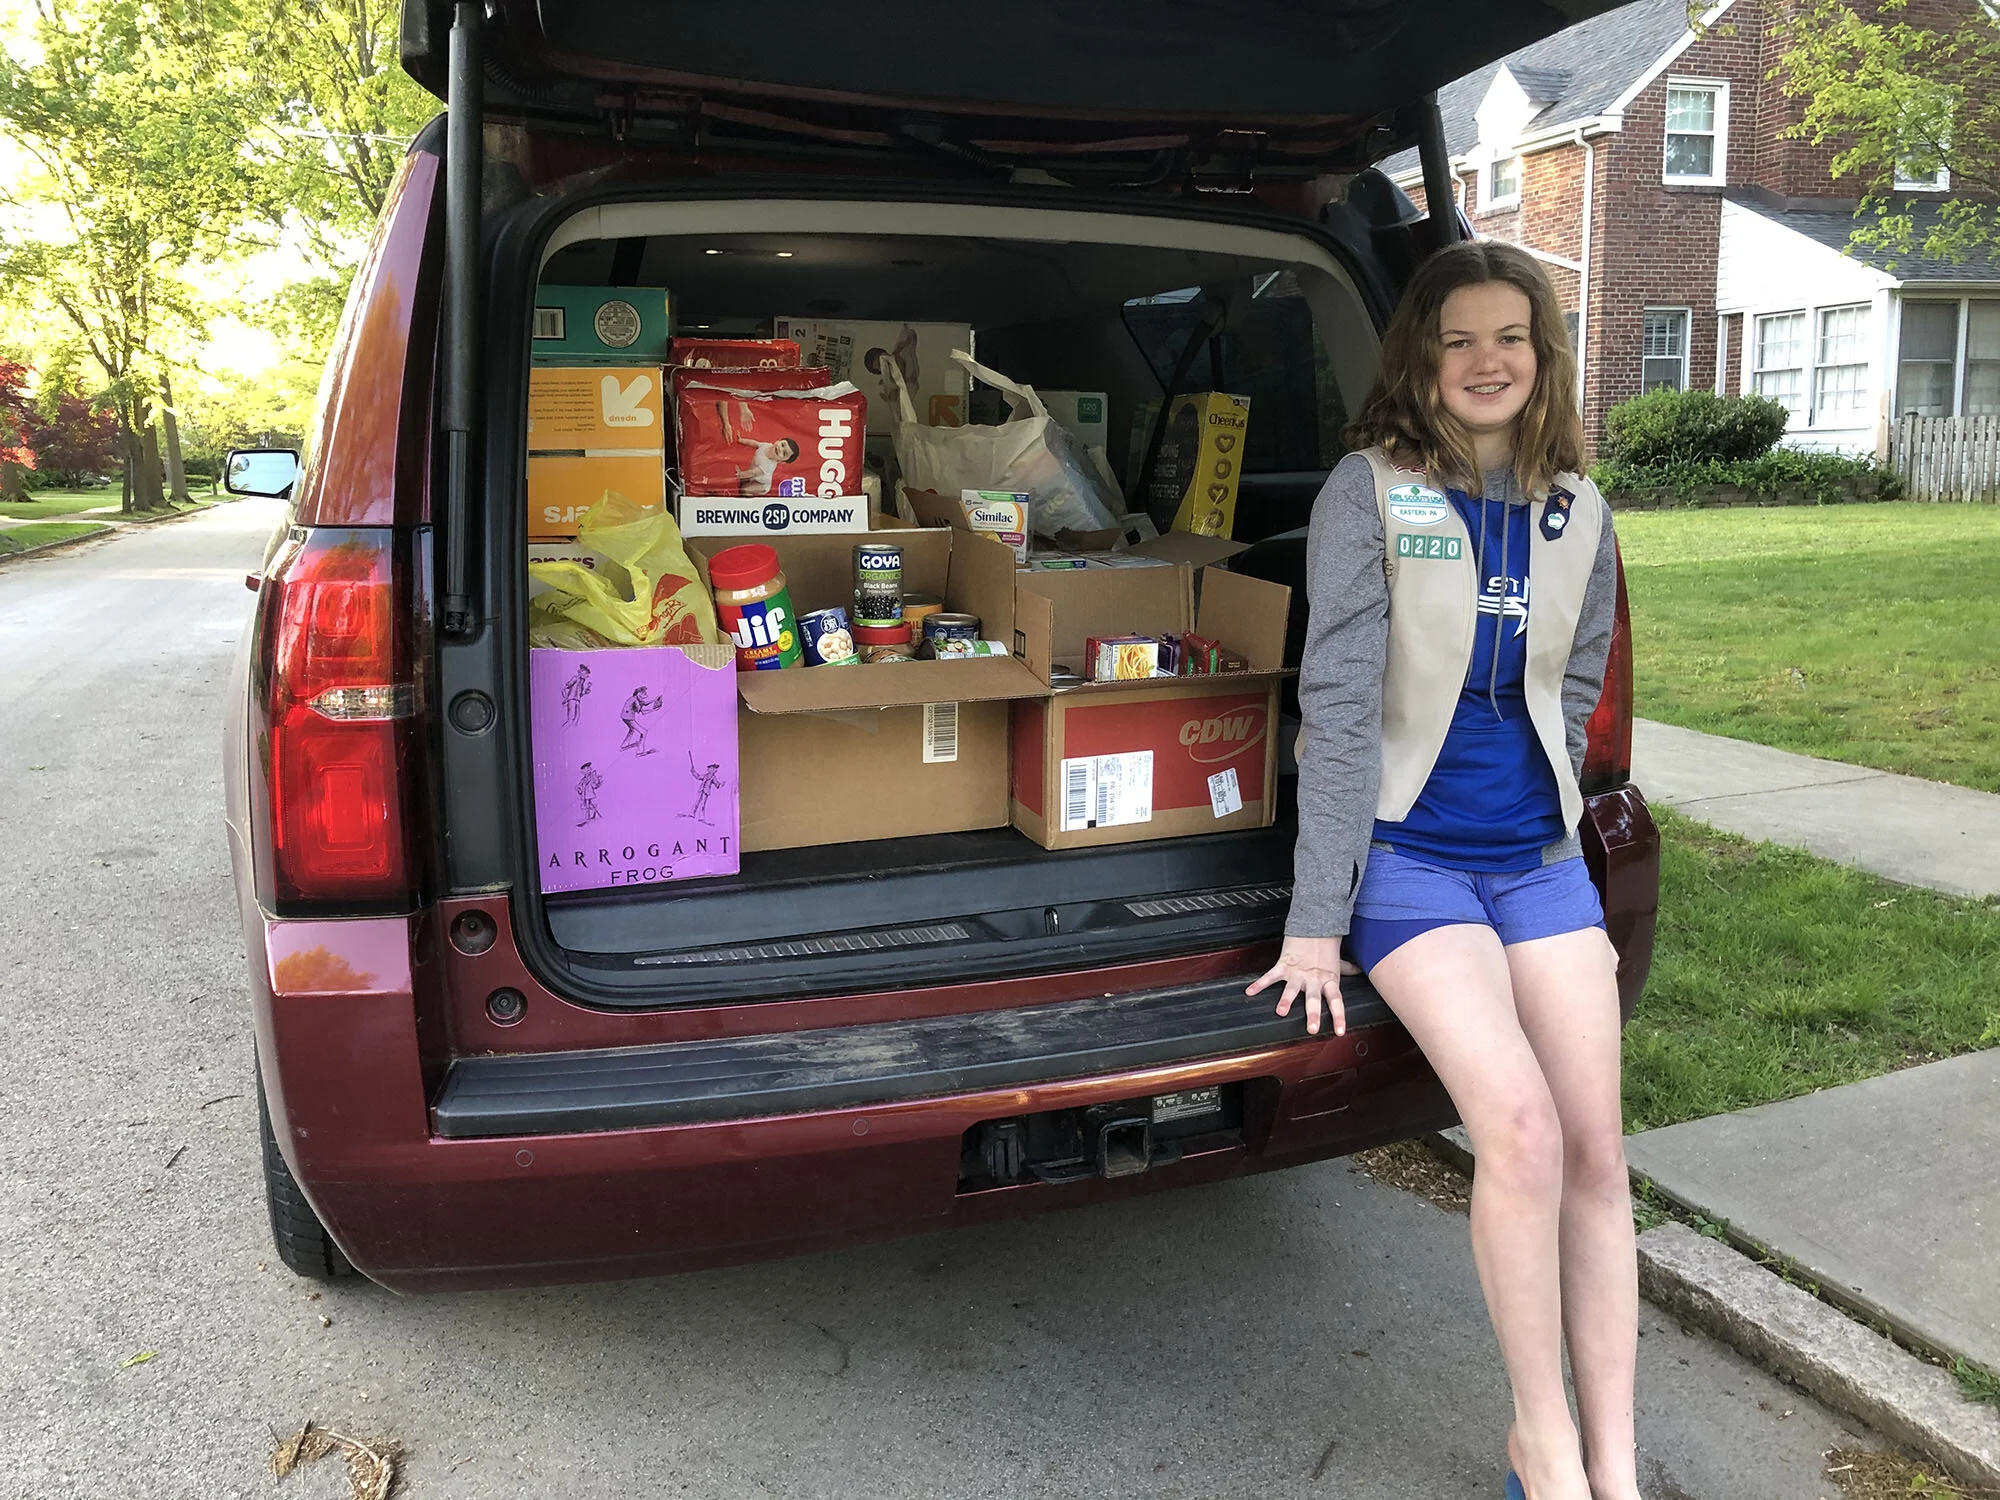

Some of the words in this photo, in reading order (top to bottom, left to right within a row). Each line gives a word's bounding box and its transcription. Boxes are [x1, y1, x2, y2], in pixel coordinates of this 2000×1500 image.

[818, 408, 852, 499] HUGG
[1389, 494, 1403, 502] GIRL
[1404, 495, 1430, 503] SCOUTS
[696, 509, 760, 524] BREWING
[764, 508, 789, 525] 2SP
[791, 509, 855, 524] COMPANY
[974, 510, 1013, 523] Similac
[1399, 537, 1459, 557] 0220
[861, 555, 900, 569] GOYA
[859, 572, 902, 581] ORGANICS
[730, 607, 786, 649] Jif
[1179, 715, 1255, 746] CDW
[548, 836, 730, 868] ARROGANT
[611, 865, 674, 884] FROG
